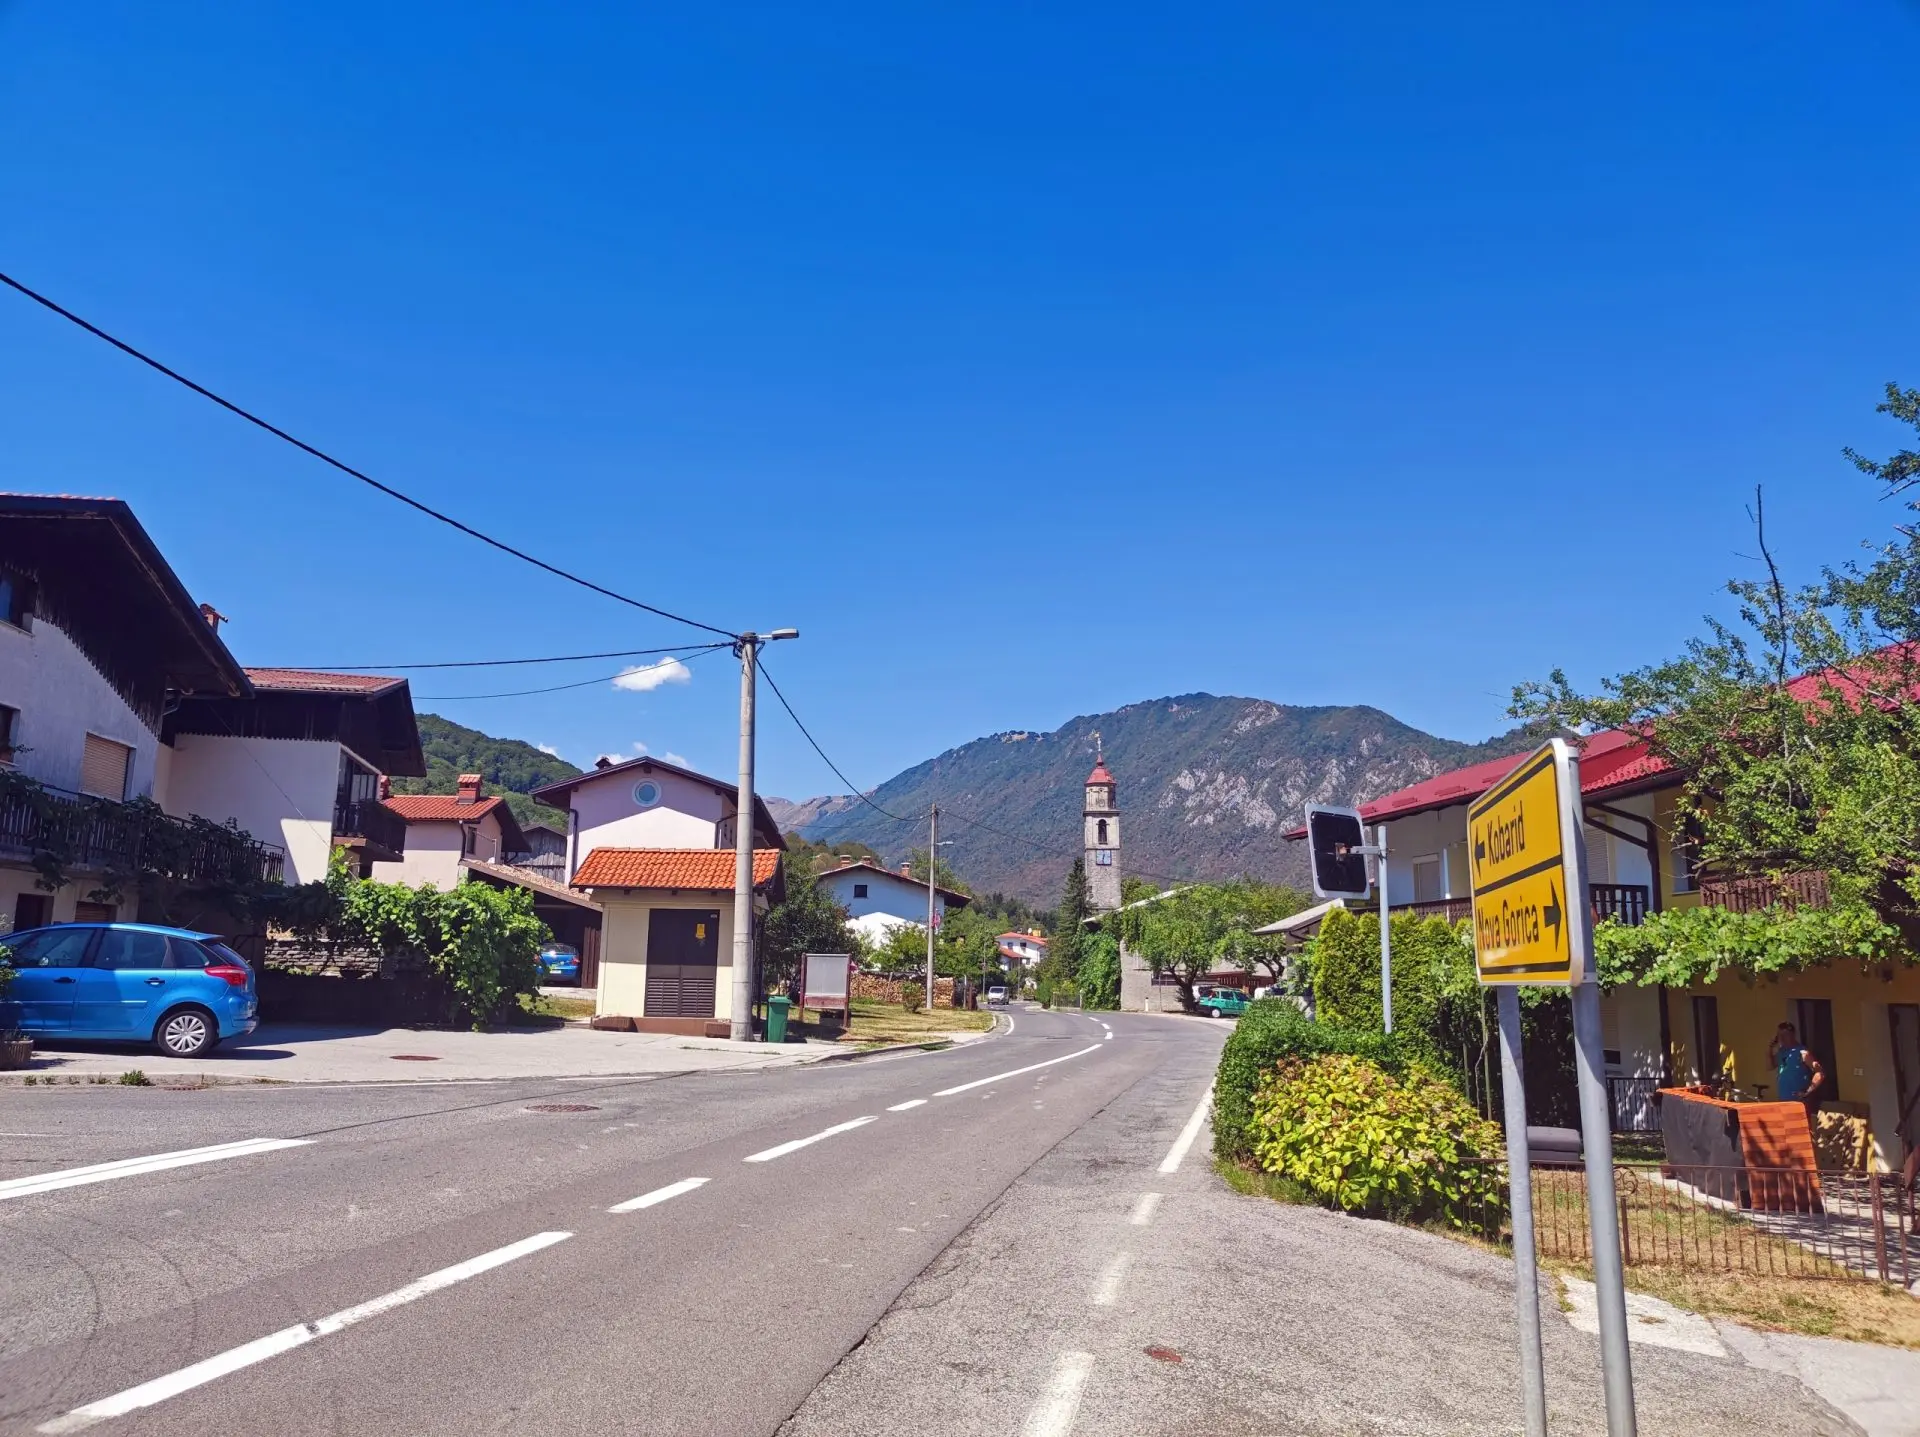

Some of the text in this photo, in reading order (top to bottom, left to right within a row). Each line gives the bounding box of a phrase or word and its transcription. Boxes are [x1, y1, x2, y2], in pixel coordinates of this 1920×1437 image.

[1488, 801, 1525, 866] Kobarid
[1478, 896, 1539, 951] Nova Gorica
